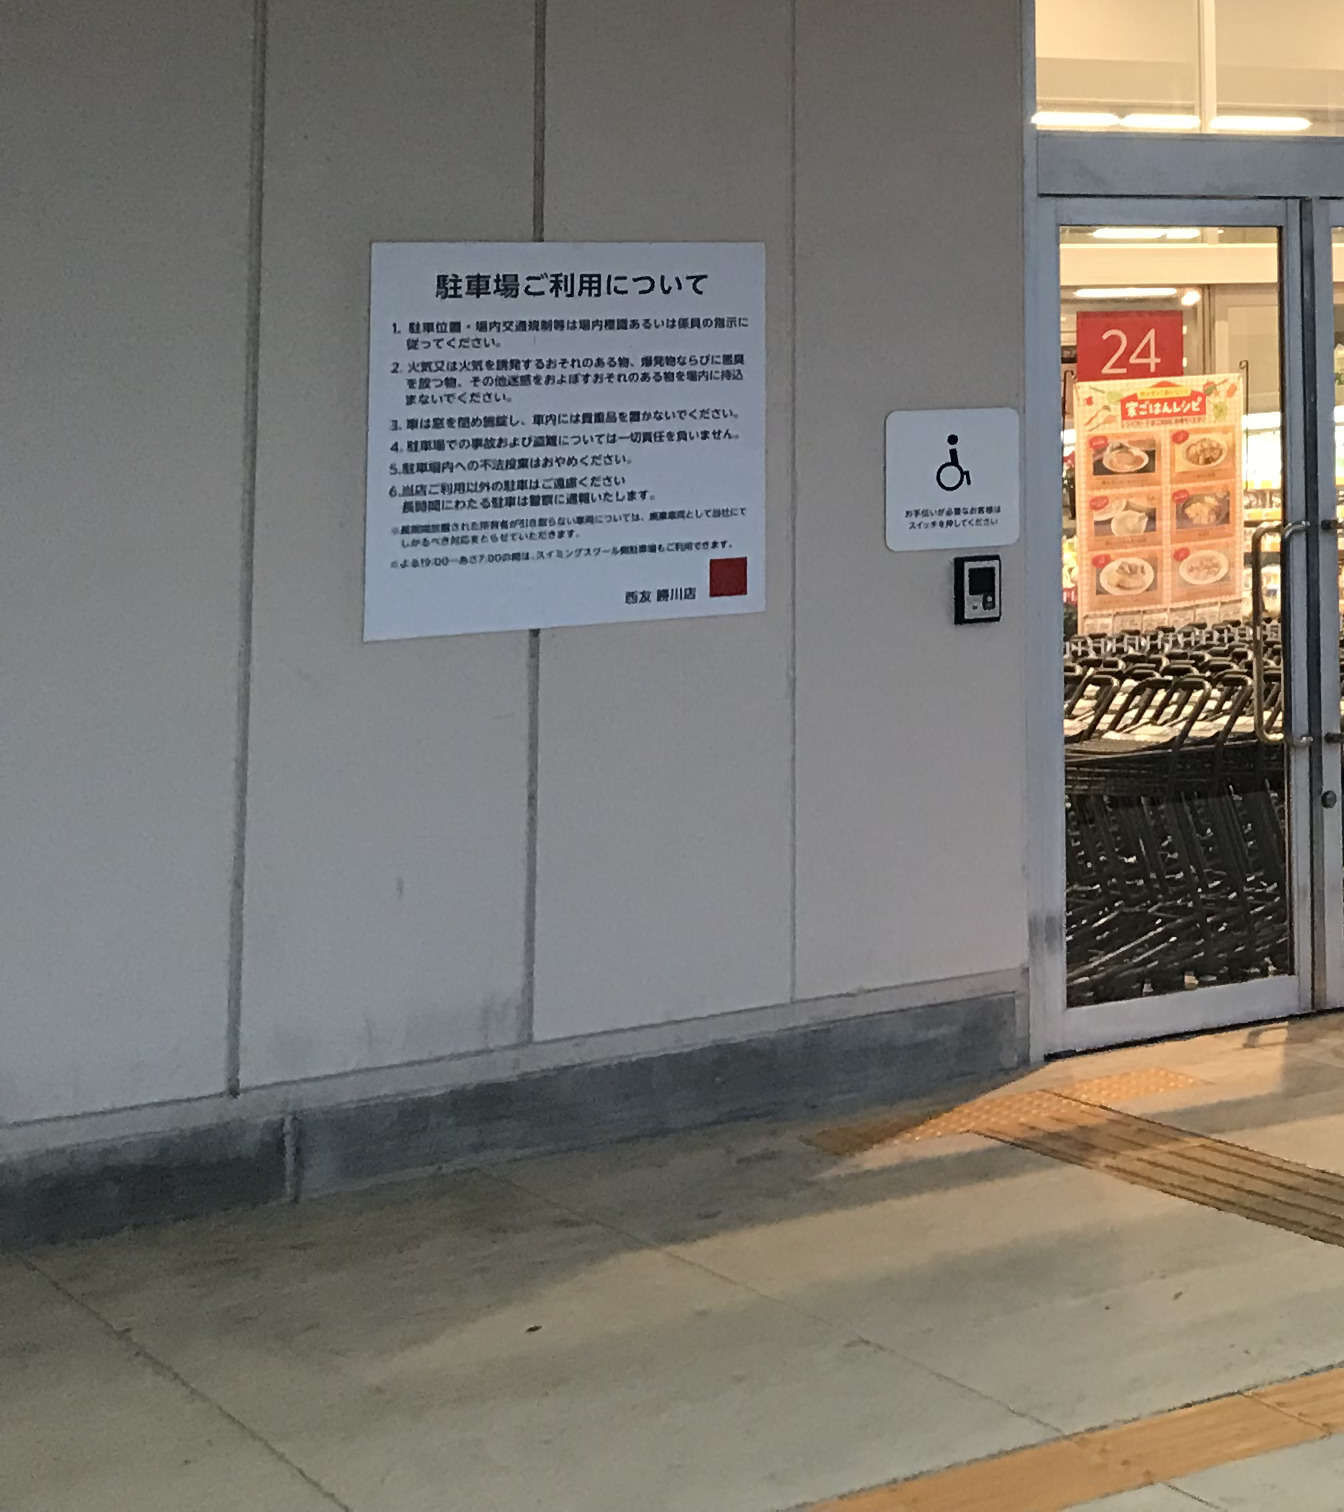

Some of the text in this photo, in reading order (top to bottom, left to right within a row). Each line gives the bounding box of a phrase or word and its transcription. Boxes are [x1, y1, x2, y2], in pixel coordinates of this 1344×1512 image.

[435, 272, 710, 300] 駐車場ご利用について
[1101, 328, 1161, 374] 24
[1125, 396, 1203, 418] 家ごはんレシピ
[625, 590, 652, 605] 西友
